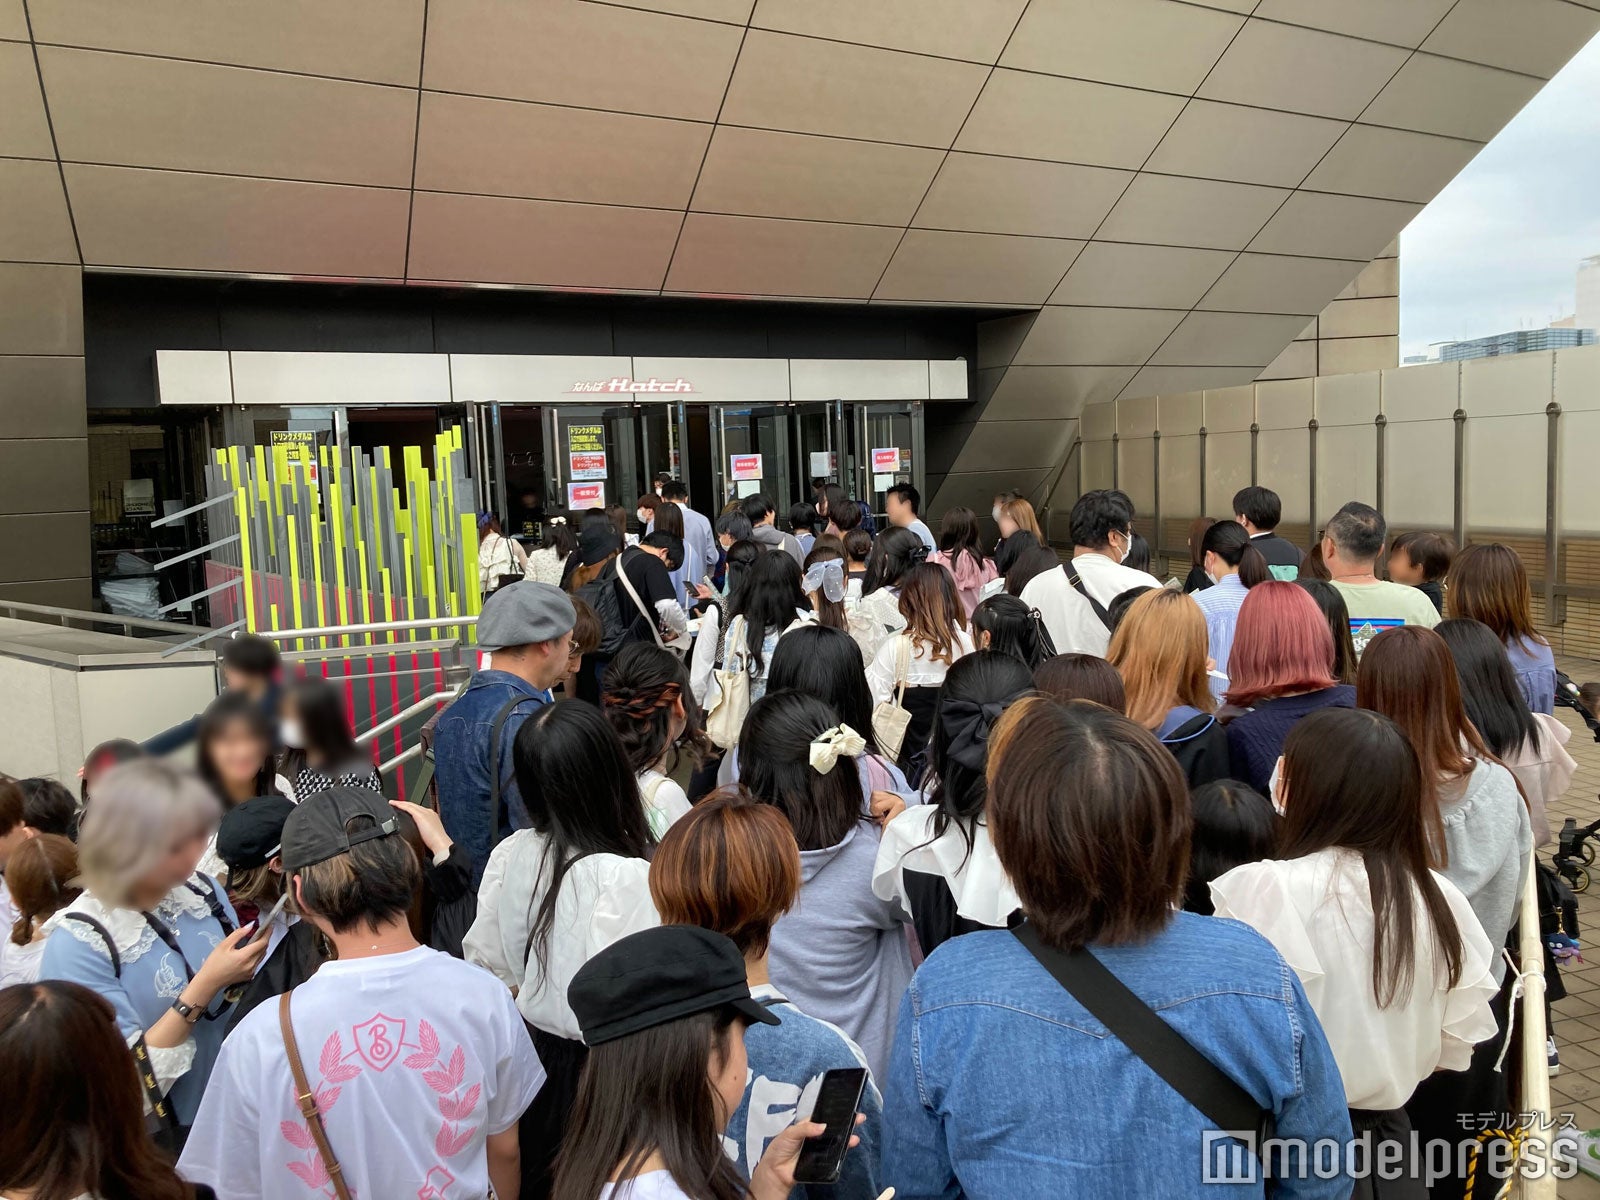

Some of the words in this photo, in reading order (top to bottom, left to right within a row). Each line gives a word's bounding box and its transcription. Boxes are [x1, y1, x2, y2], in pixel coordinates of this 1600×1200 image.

[571, 381, 606, 393] なんば
[607, 376, 693, 393] Hatch
[273, 432, 313, 441] ドリンクメダルは
